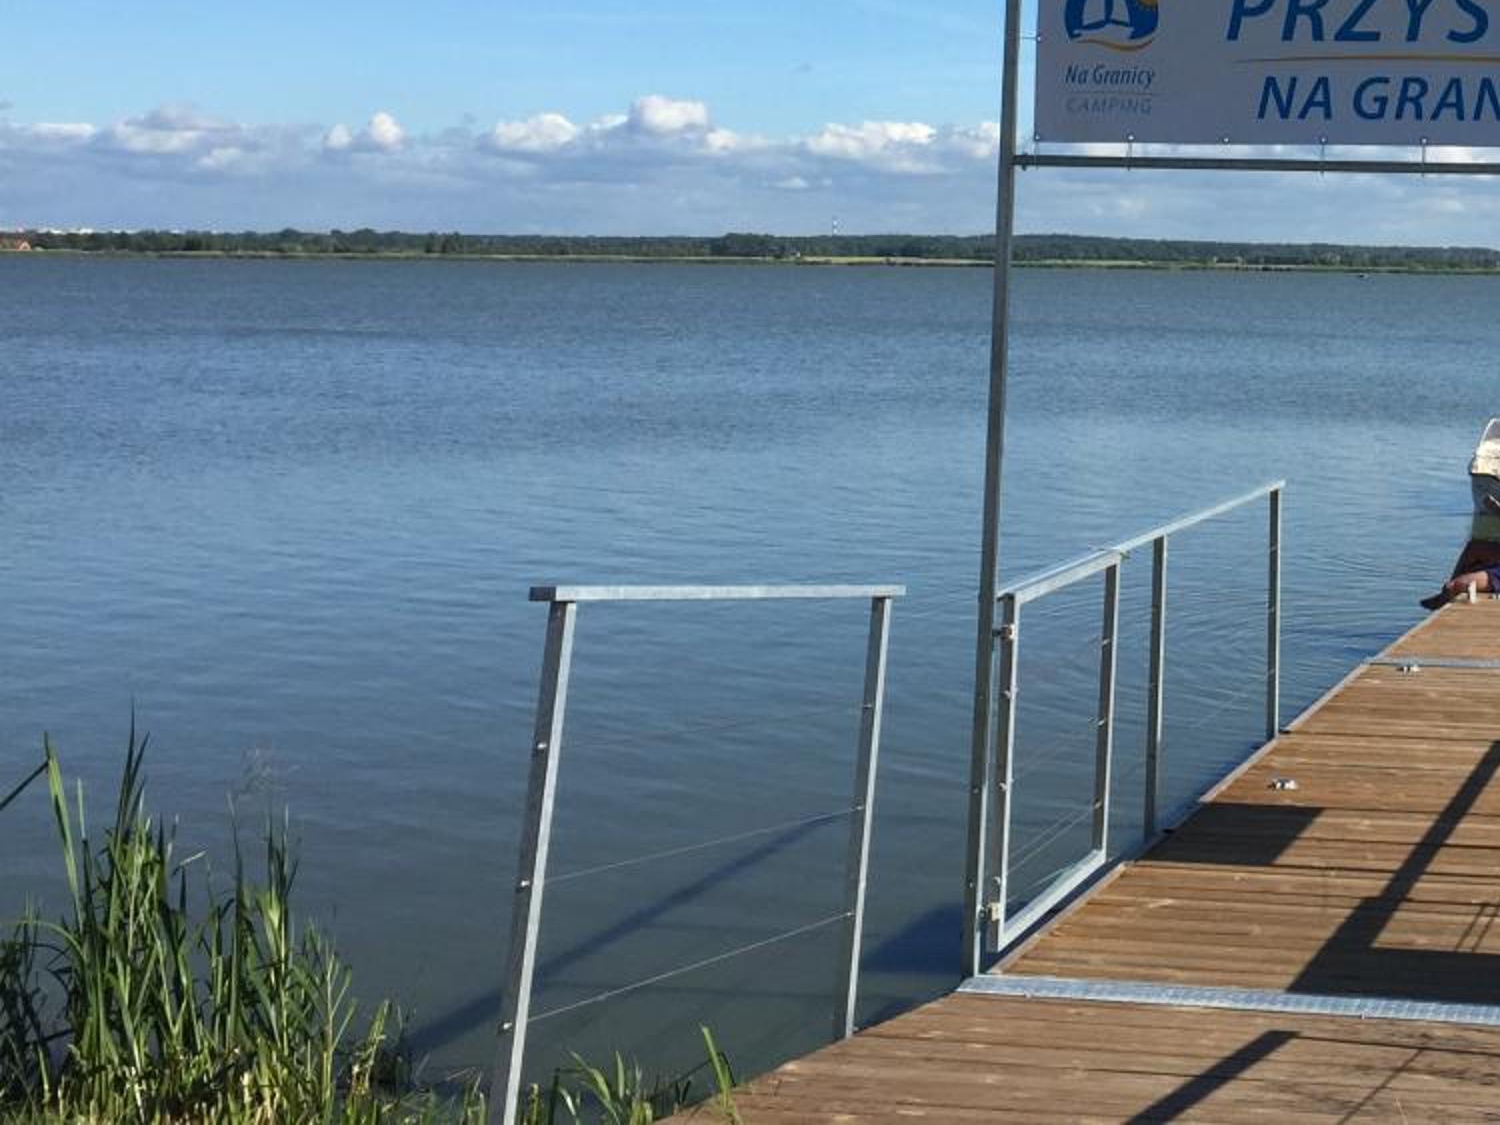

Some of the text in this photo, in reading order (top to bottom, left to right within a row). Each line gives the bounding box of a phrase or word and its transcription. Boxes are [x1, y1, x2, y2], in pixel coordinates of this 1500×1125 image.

[1065, 64, 1156, 90] Na Granicy
[1065, 96, 1153, 115] CAMPING
[1257, 76, 1333, 121] NA
